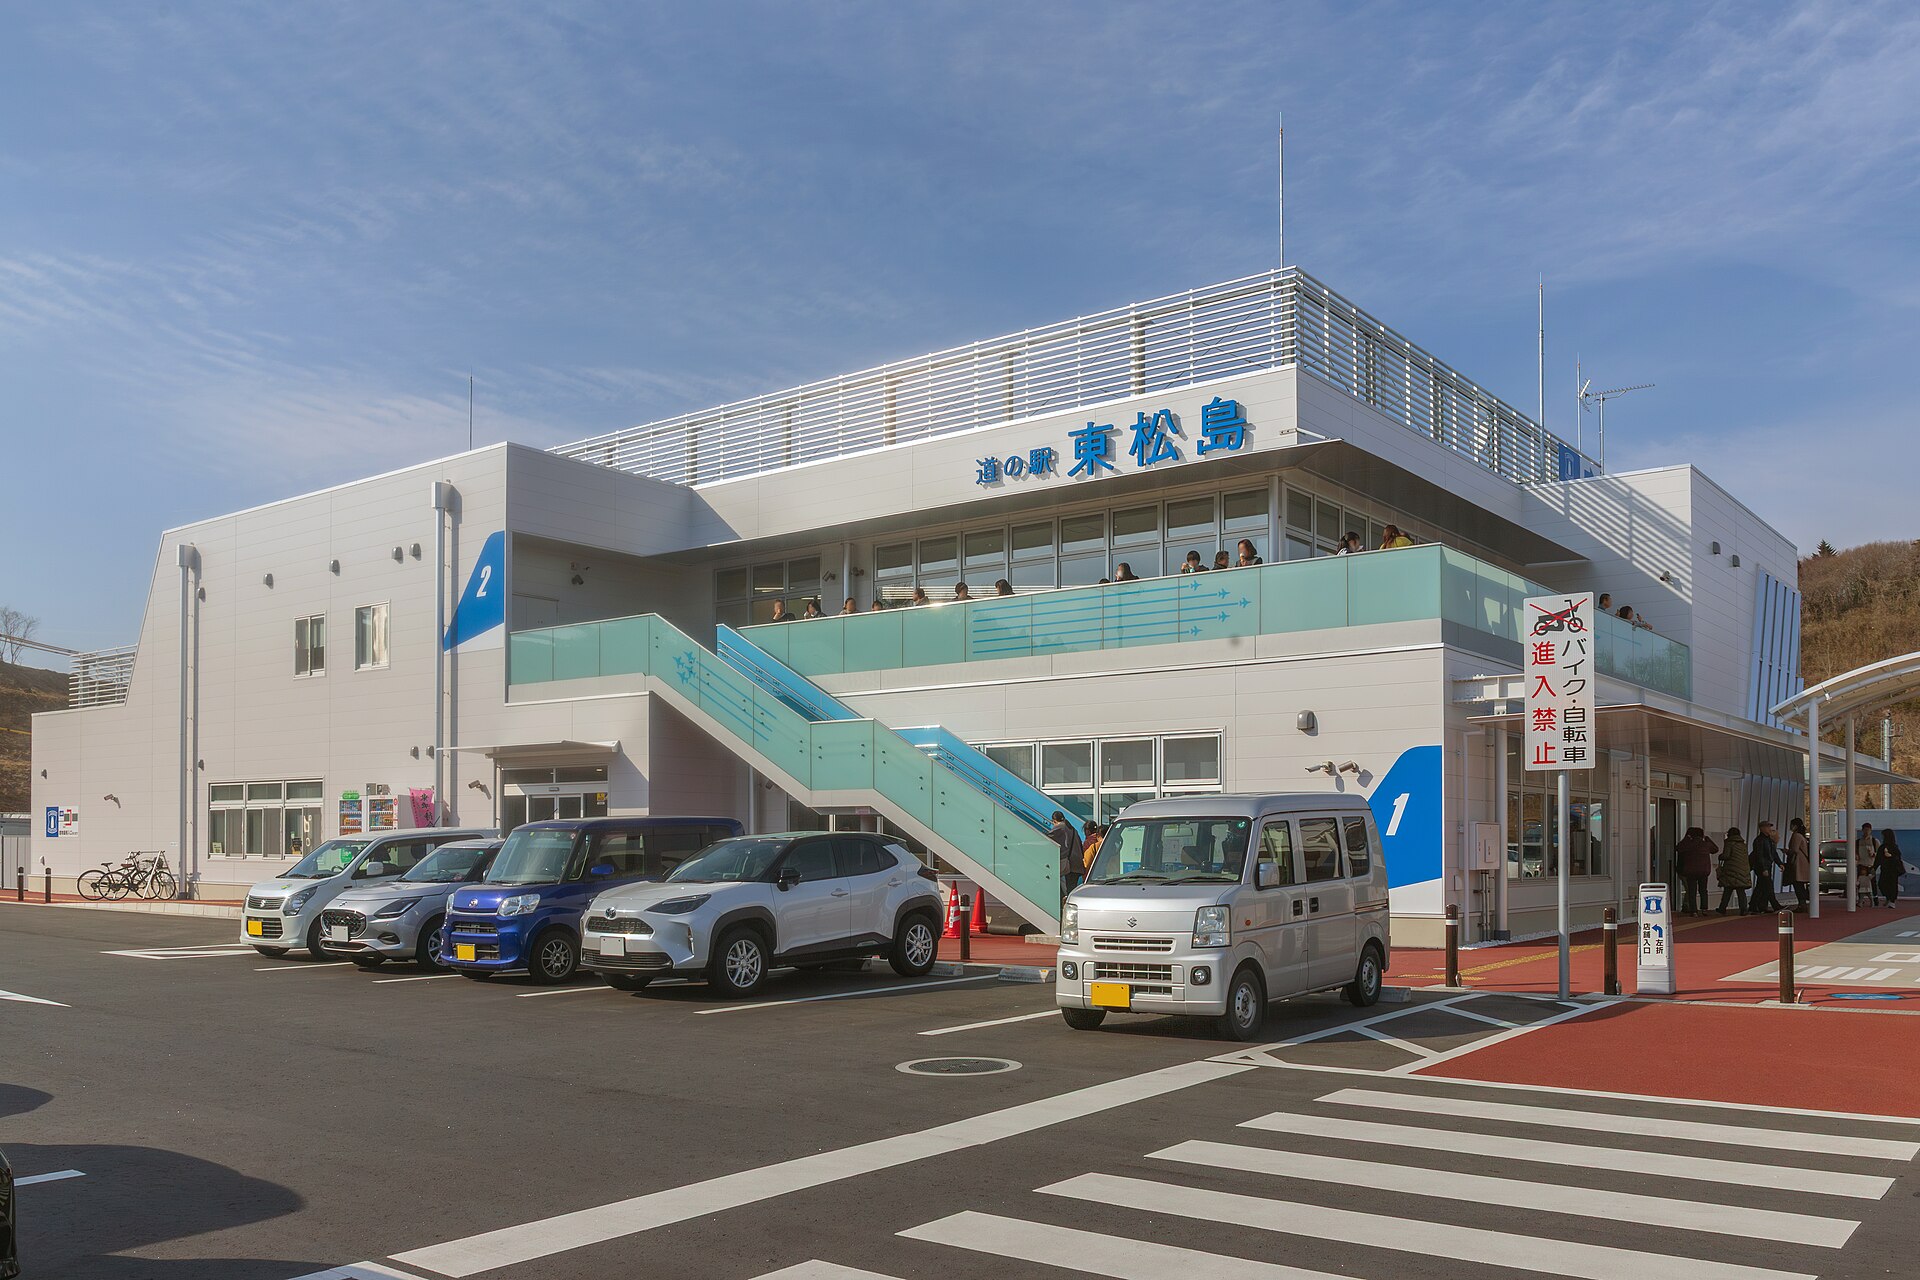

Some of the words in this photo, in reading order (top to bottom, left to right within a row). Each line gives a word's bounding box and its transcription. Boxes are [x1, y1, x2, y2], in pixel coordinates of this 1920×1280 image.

[975, 447, 1053, 485] 道の駅
[1067, 396, 1247, 478] 東松島
[477, 565, 492, 598] 2
[1531, 640, 1557, 765] 進入禁止
[1562, 637, 1587, 764] バイク・自転車
[1386, 793, 1410, 836] 1
[1655, 938, 1664, 955] 左折
